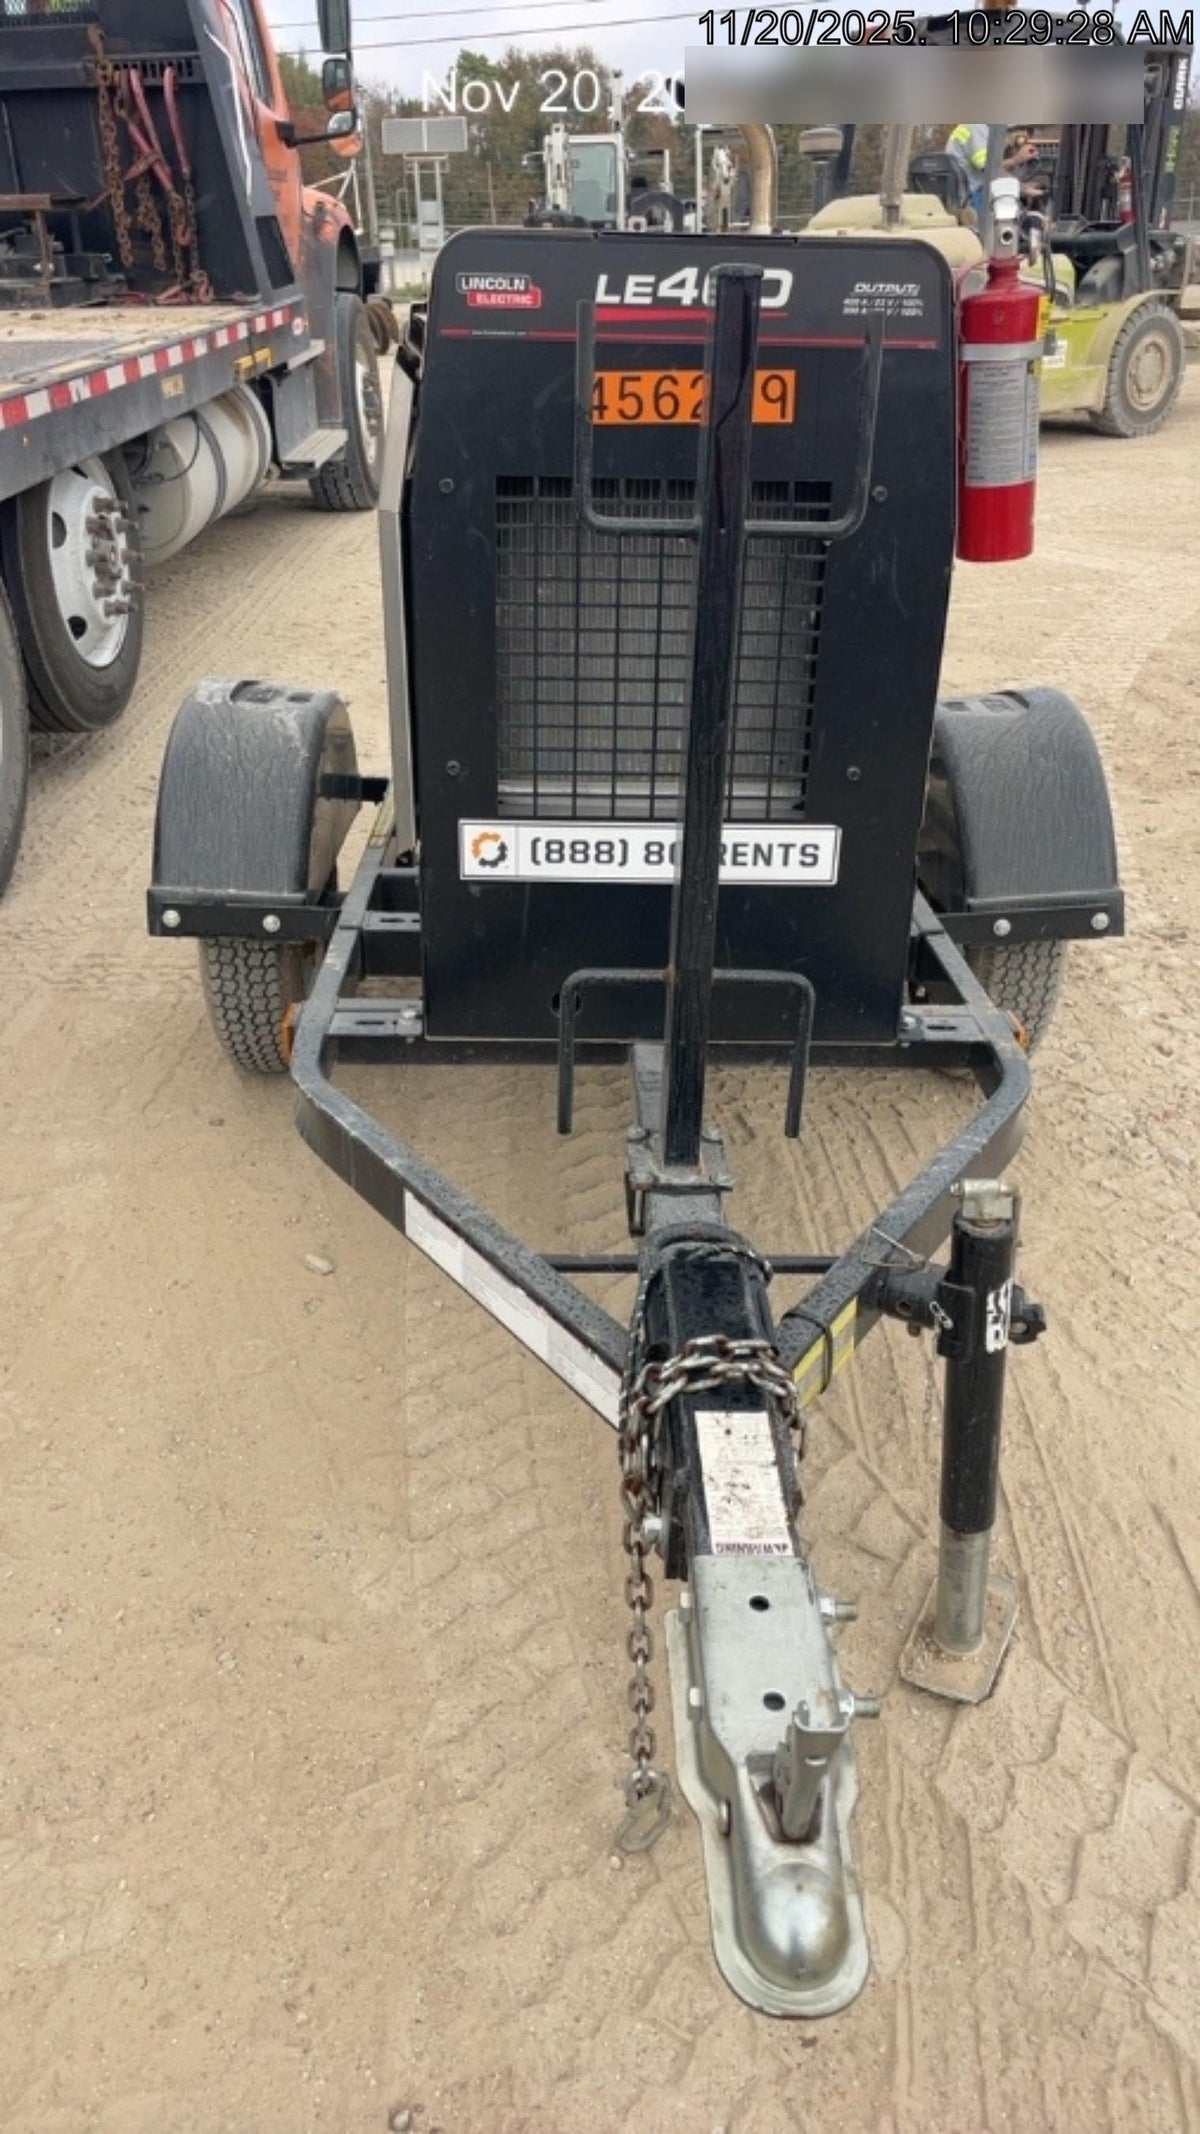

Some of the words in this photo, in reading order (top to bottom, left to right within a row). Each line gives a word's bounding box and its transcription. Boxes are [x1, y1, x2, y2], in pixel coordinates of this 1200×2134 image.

[461, 275, 526, 292] LINCOLN
[476, 292, 533, 305] ELECTRIC
[592, 373, 788, 421] 45629
[531, 837, 629, 867] (888)
